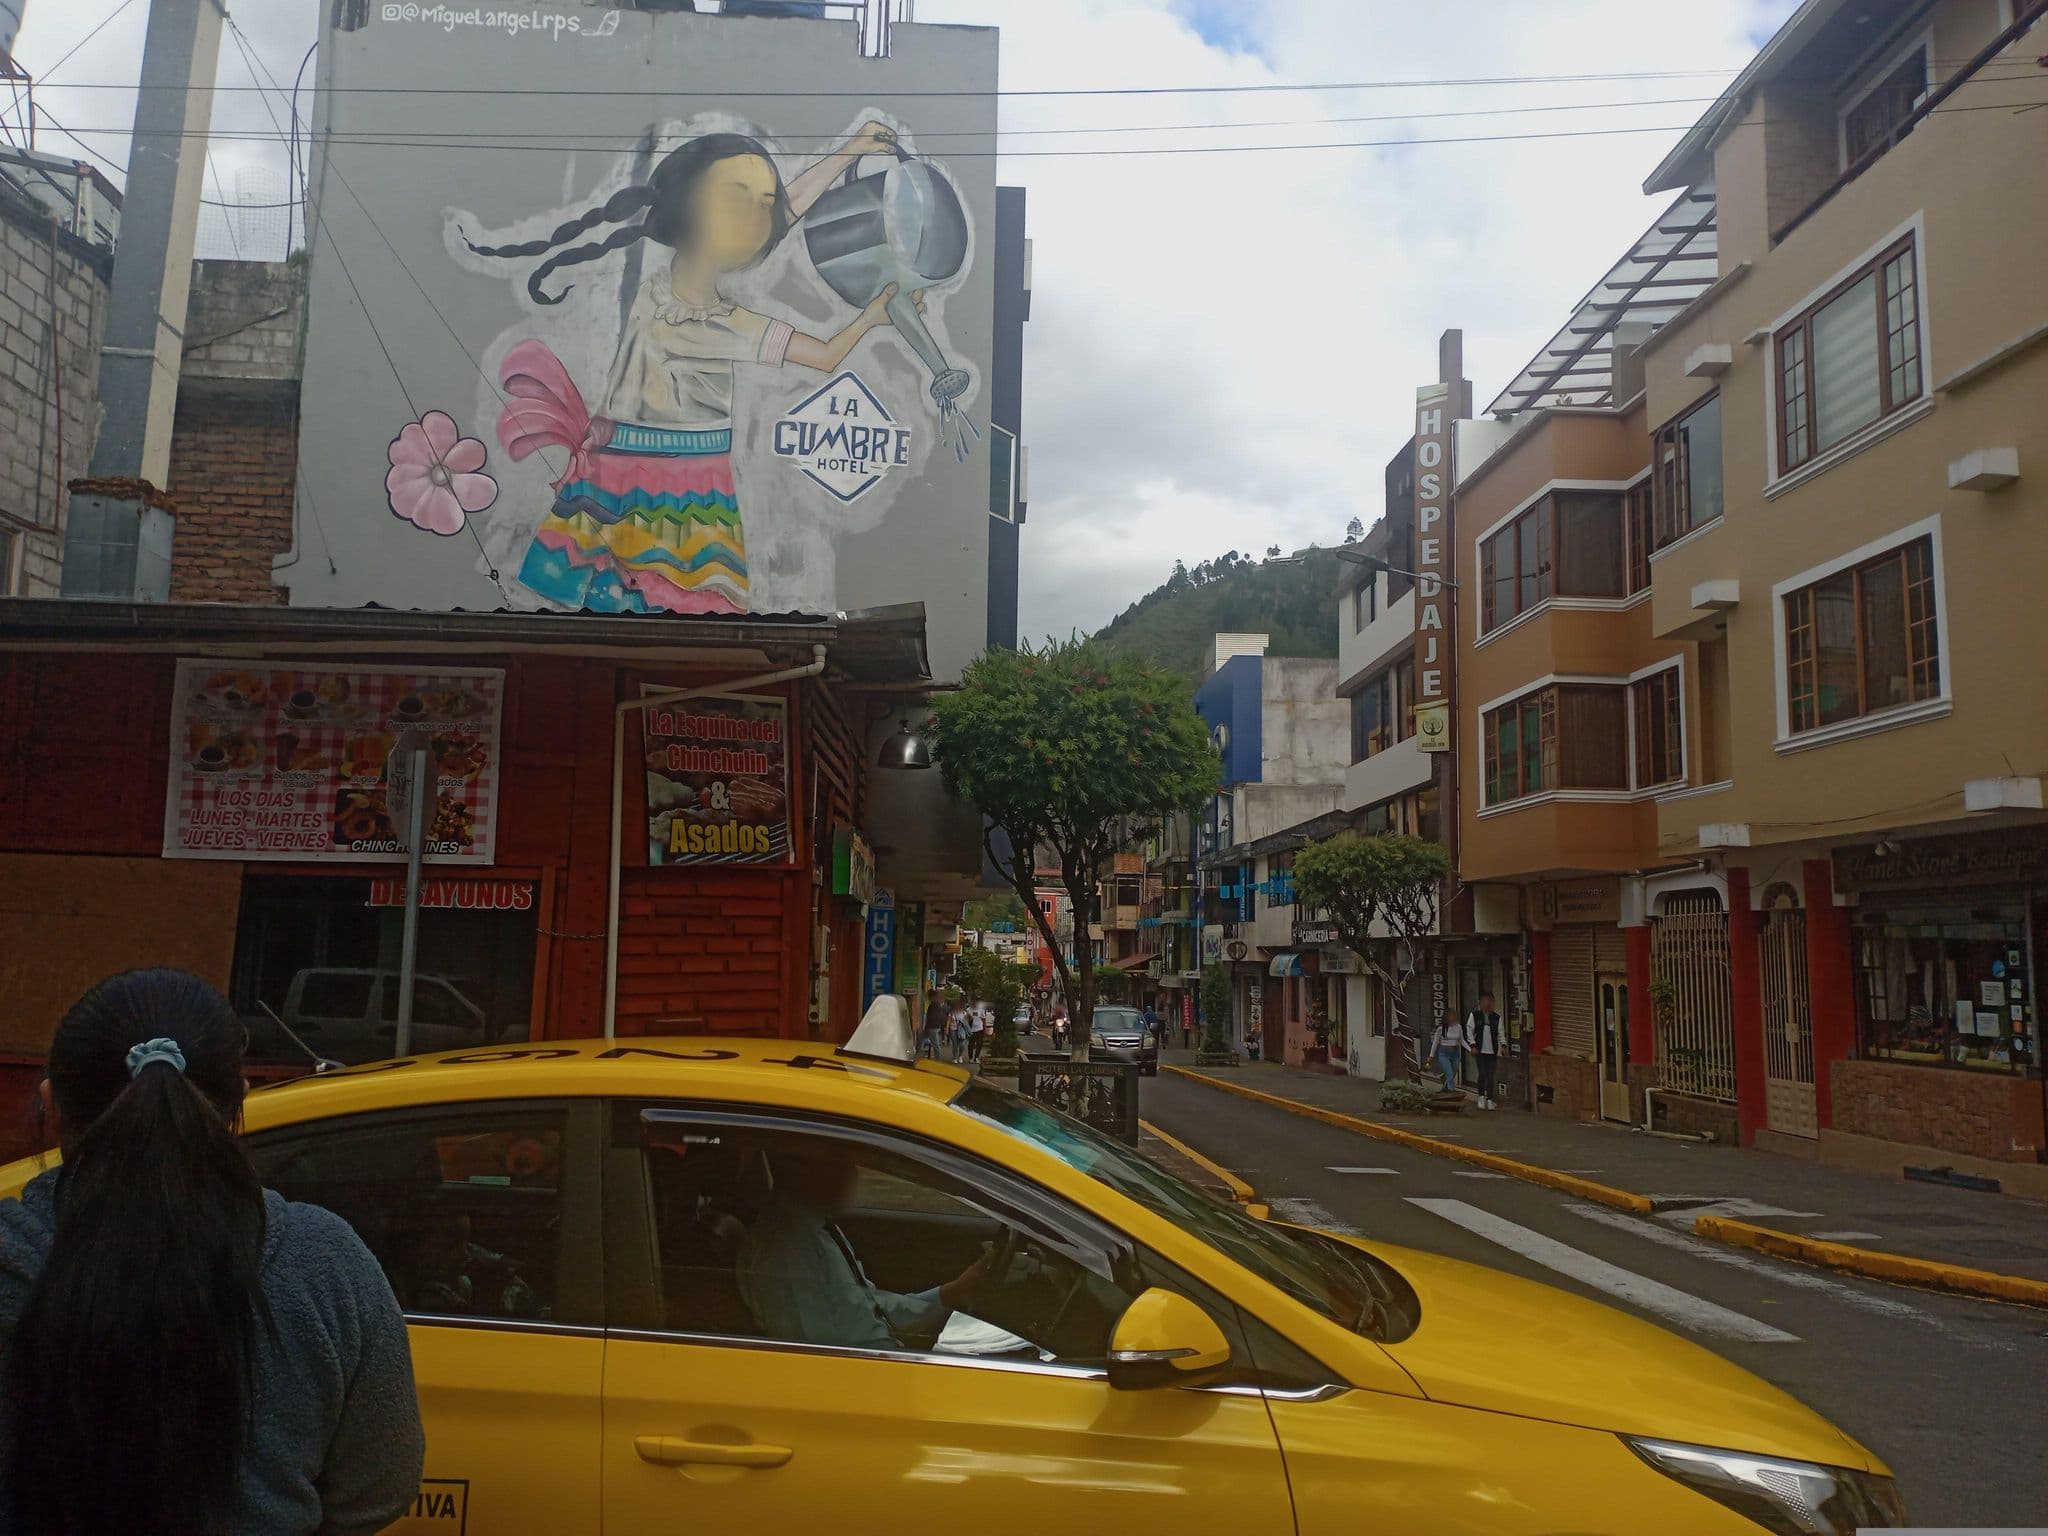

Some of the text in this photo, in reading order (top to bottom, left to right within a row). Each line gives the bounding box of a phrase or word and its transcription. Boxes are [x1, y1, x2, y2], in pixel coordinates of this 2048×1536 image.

[829, 396, 858, 417] LA
[774, 420, 911, 465] CUMBRE
[817, 458, 869, 474] HOTEL
[1419, 407, 1443, 697] HOSPEDAJE
[650, 708, 781, 743] La Esquina del
[666, 743, 769, 775] Chinchulin
[217, 790, 294, 808] LOS DIAS
[710, 781, 730, 810] &
[190, 809, 242, 826] LUNES
[255, 812, 323, 828] MARTES
[183, 830, 245, 846] JUEVES
[258, 832, 328, 849] VIERNES
[351, 839, 460, 855] CHINCHINES
[669, 818, 770, 854] Asados
[871, 911, 890, 997] HOTE
[403, 1492, 456, 1518] IVA
